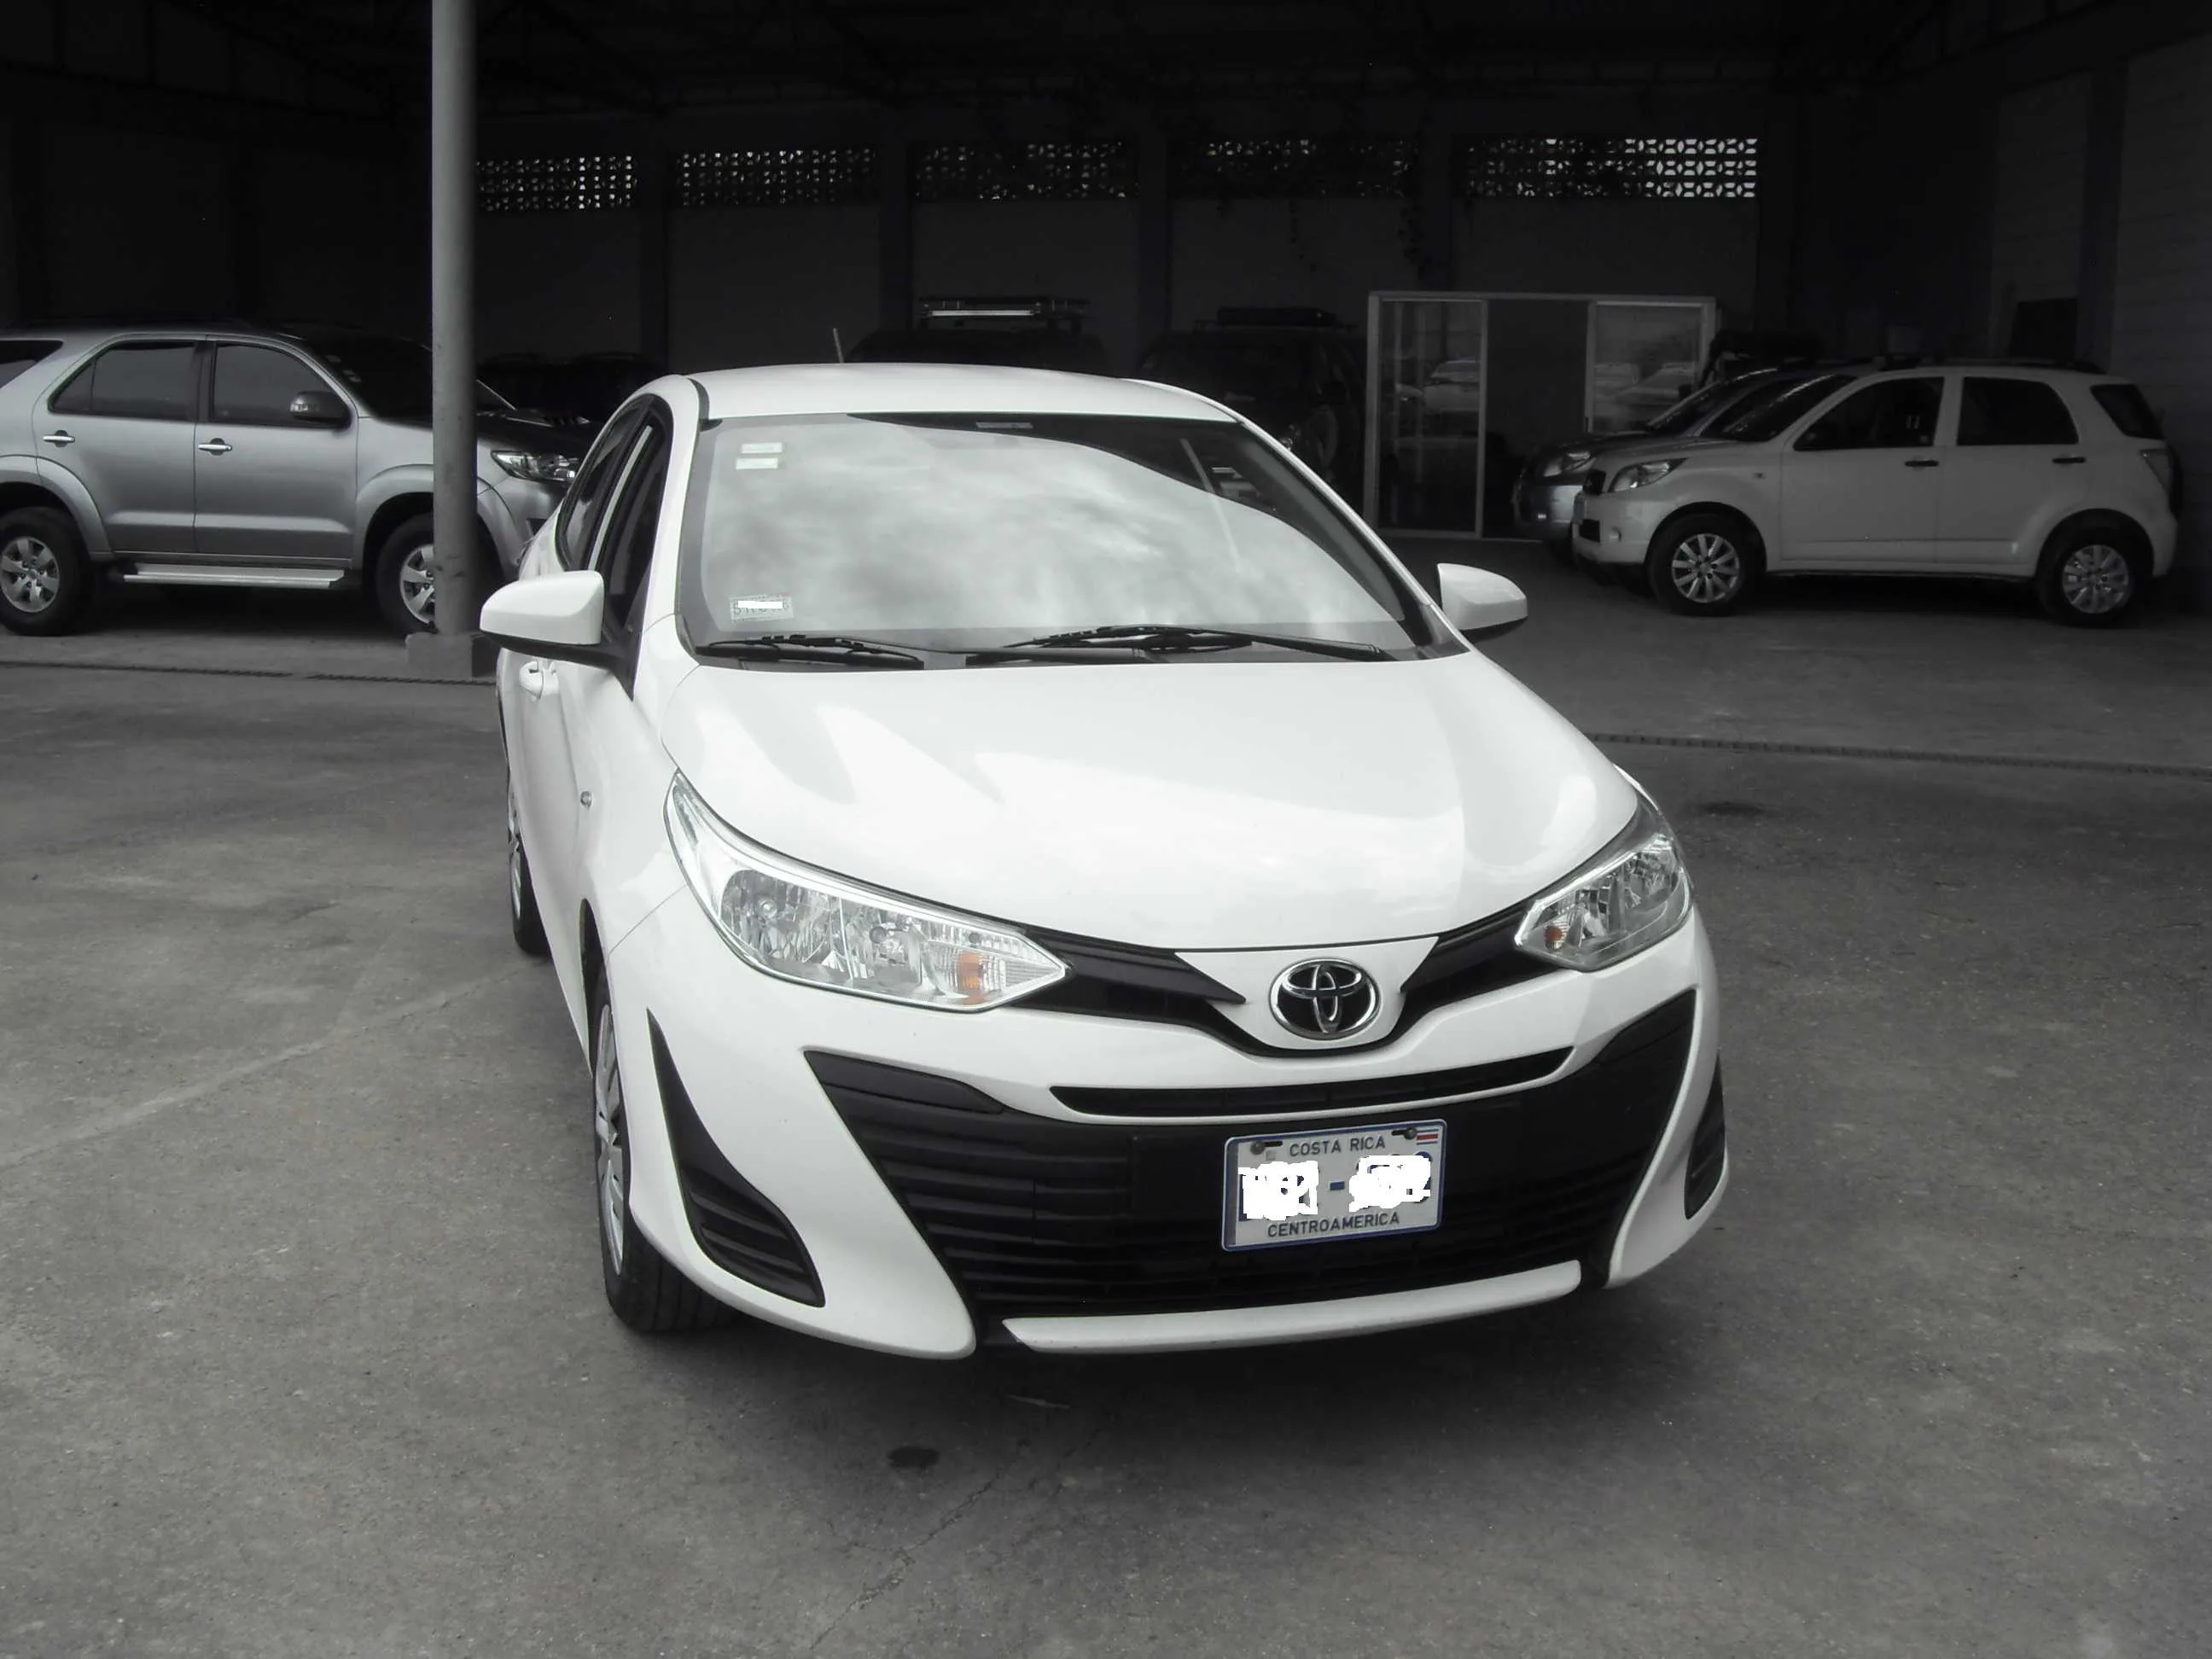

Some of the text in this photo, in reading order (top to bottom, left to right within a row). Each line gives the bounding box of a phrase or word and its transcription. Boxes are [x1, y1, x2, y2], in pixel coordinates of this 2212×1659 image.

[1289, 1136, 1386, 1157] COSTA RICA
[1267, 1212, 1400, 1237] CENTROAMERICA
